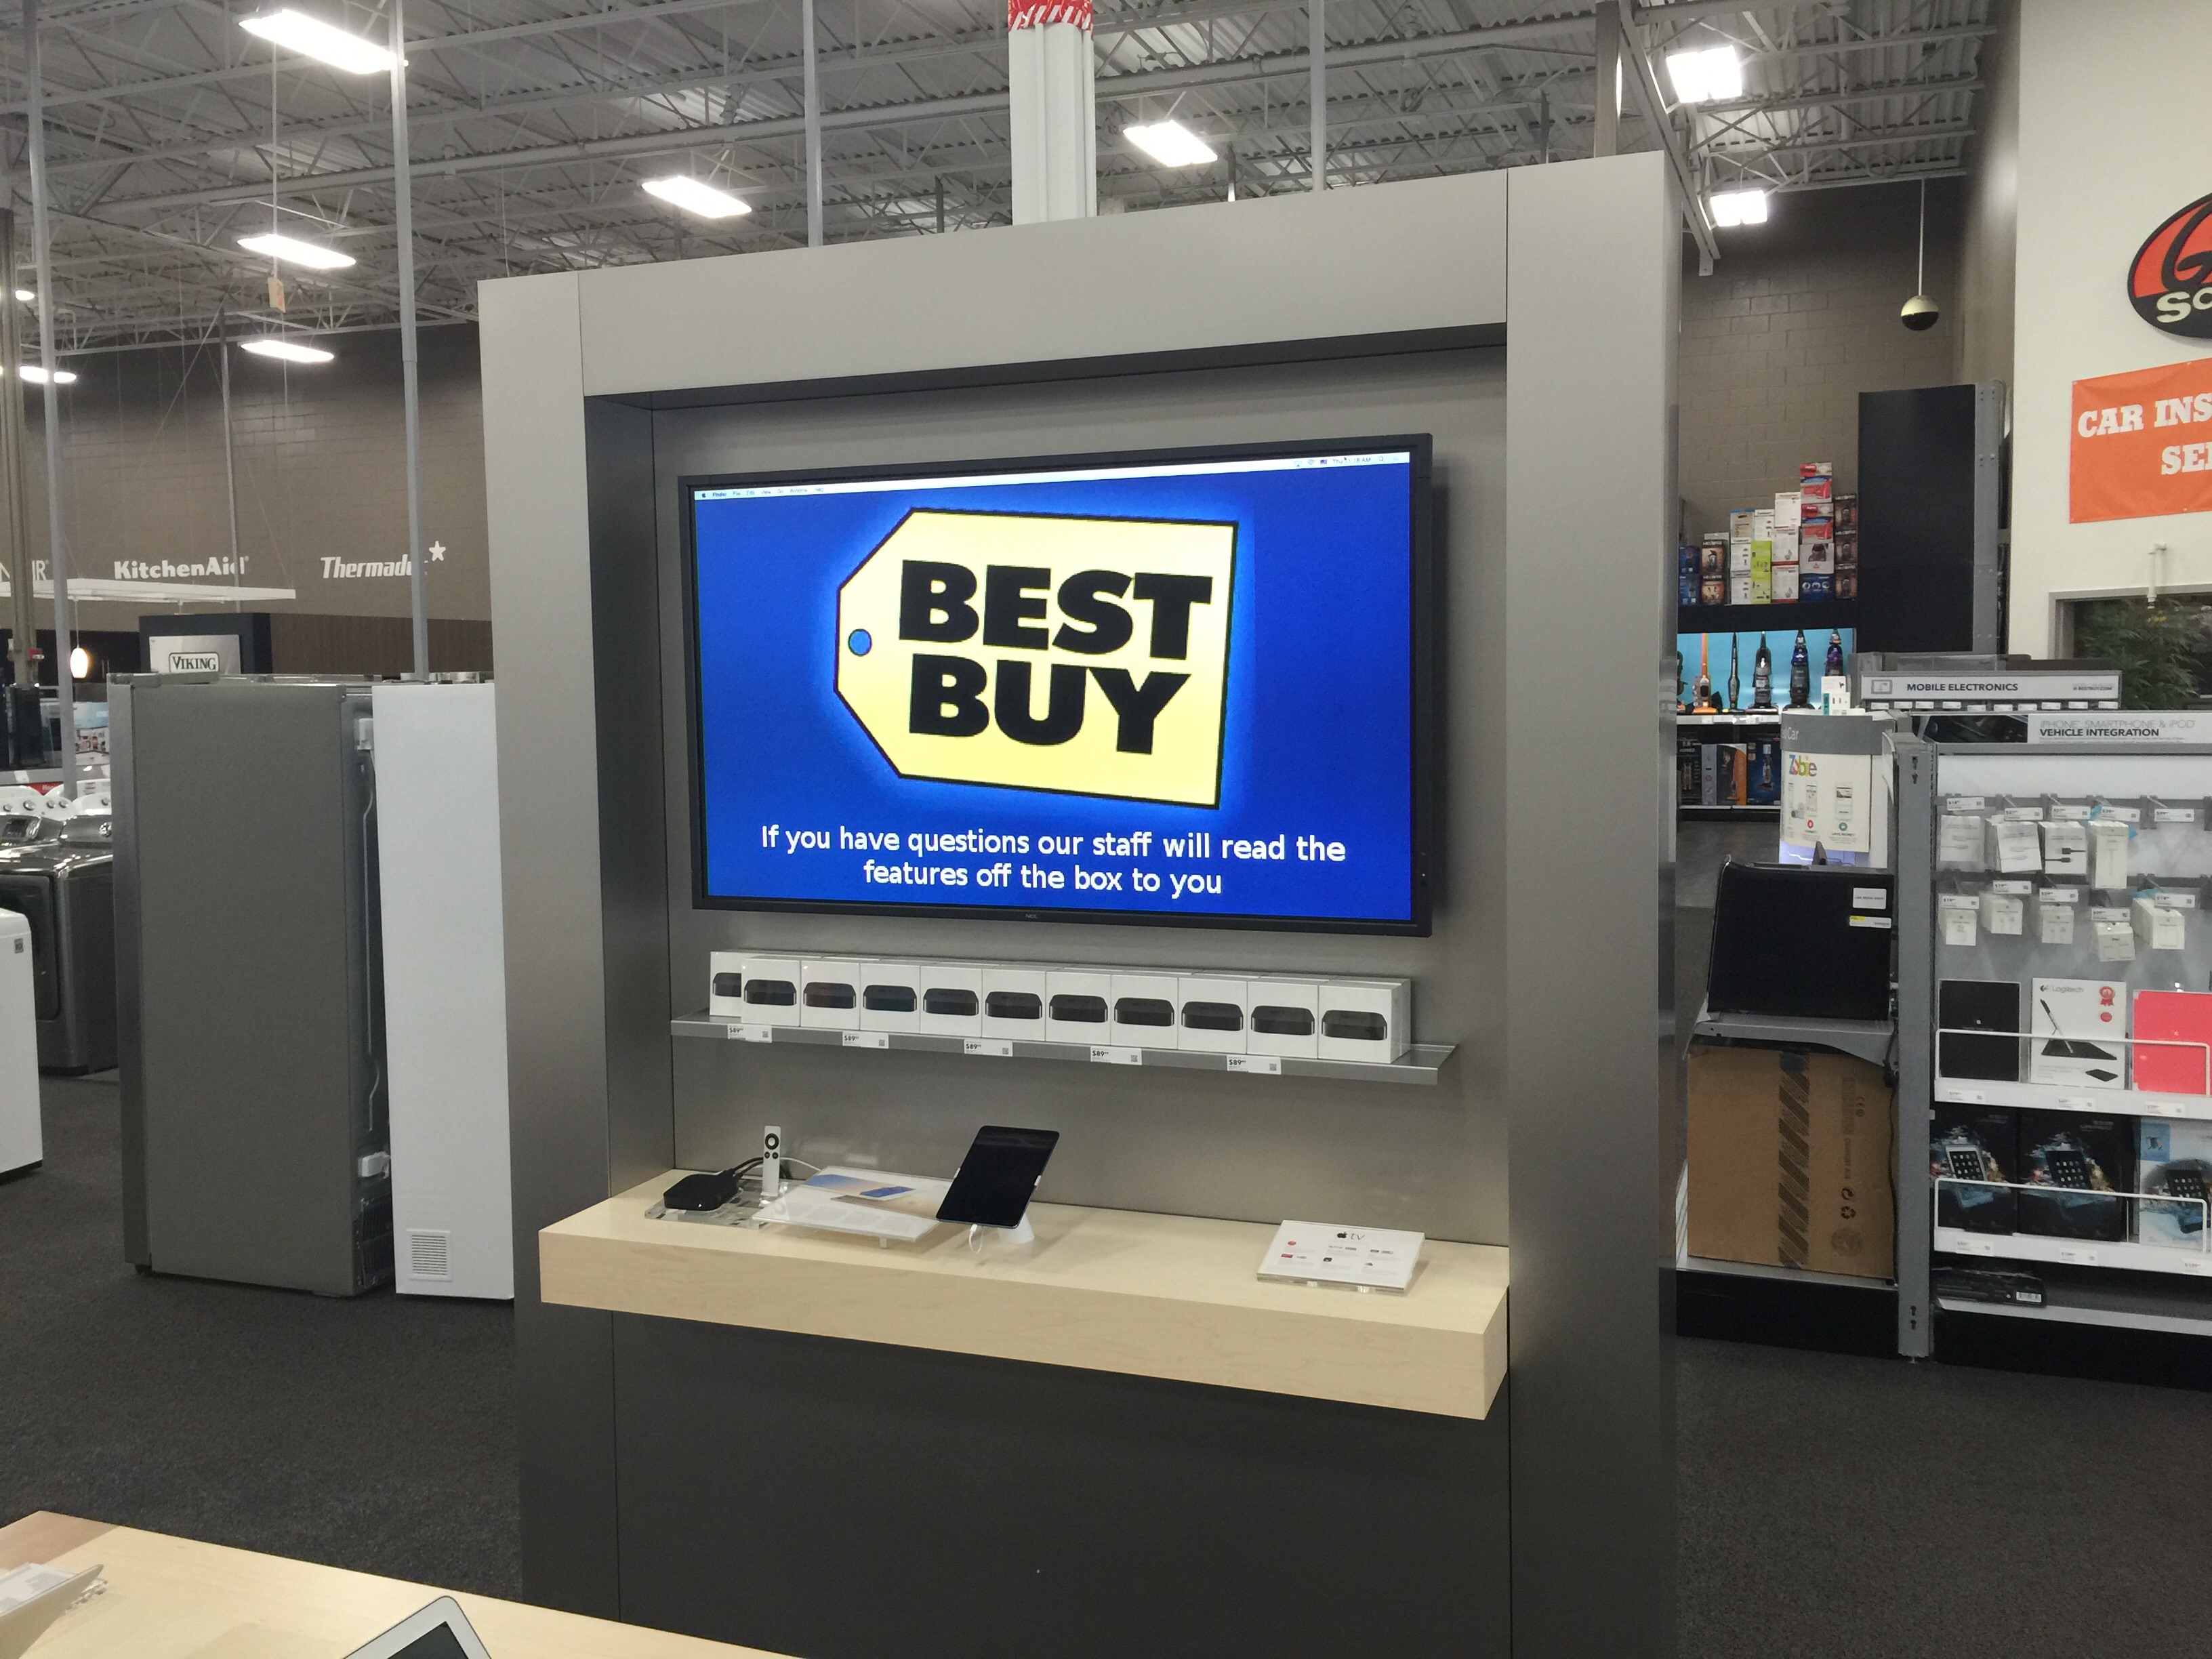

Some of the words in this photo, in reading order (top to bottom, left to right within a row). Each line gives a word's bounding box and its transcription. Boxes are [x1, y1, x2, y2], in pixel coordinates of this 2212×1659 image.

[2077, 404, 2144, 438] CAR
[321, 554, 428, 579] Thermad
[899, 560, 1212, 660] BEST
[171, 655, 217, 670] VIKING
[909, 653, 1191, 755] BUY
[1906, 683, 1945, 692] MOBILE
[1948, 682, 2019, 692] ELECTRONICS
[2040, 729, 2083, 737] VEHICLE
[2086, 729, 2160, 737] INTEGRATION
[762, 824, 779, 848] If
[785, 829, 830, 854] you
[840, 825, 900, 851] have
[908, 828, 1029, 857] questions
[1038, 834, 1083, 855] our
[1092, 832, 1152, 857] staff
[1163, 832, 1210, 858] will
[1222, 834, 1286, 860] read
[1296, 835, 1346, 861] the
[863, 859, 968, 886] features
[977, 862, 1012, 887] off
[1021, 863, 1065, 889] the
[1075, 865, 1123, 890] box
[1132, 867, 1161, 892] to
[1170, 873, 1221, 899] you
